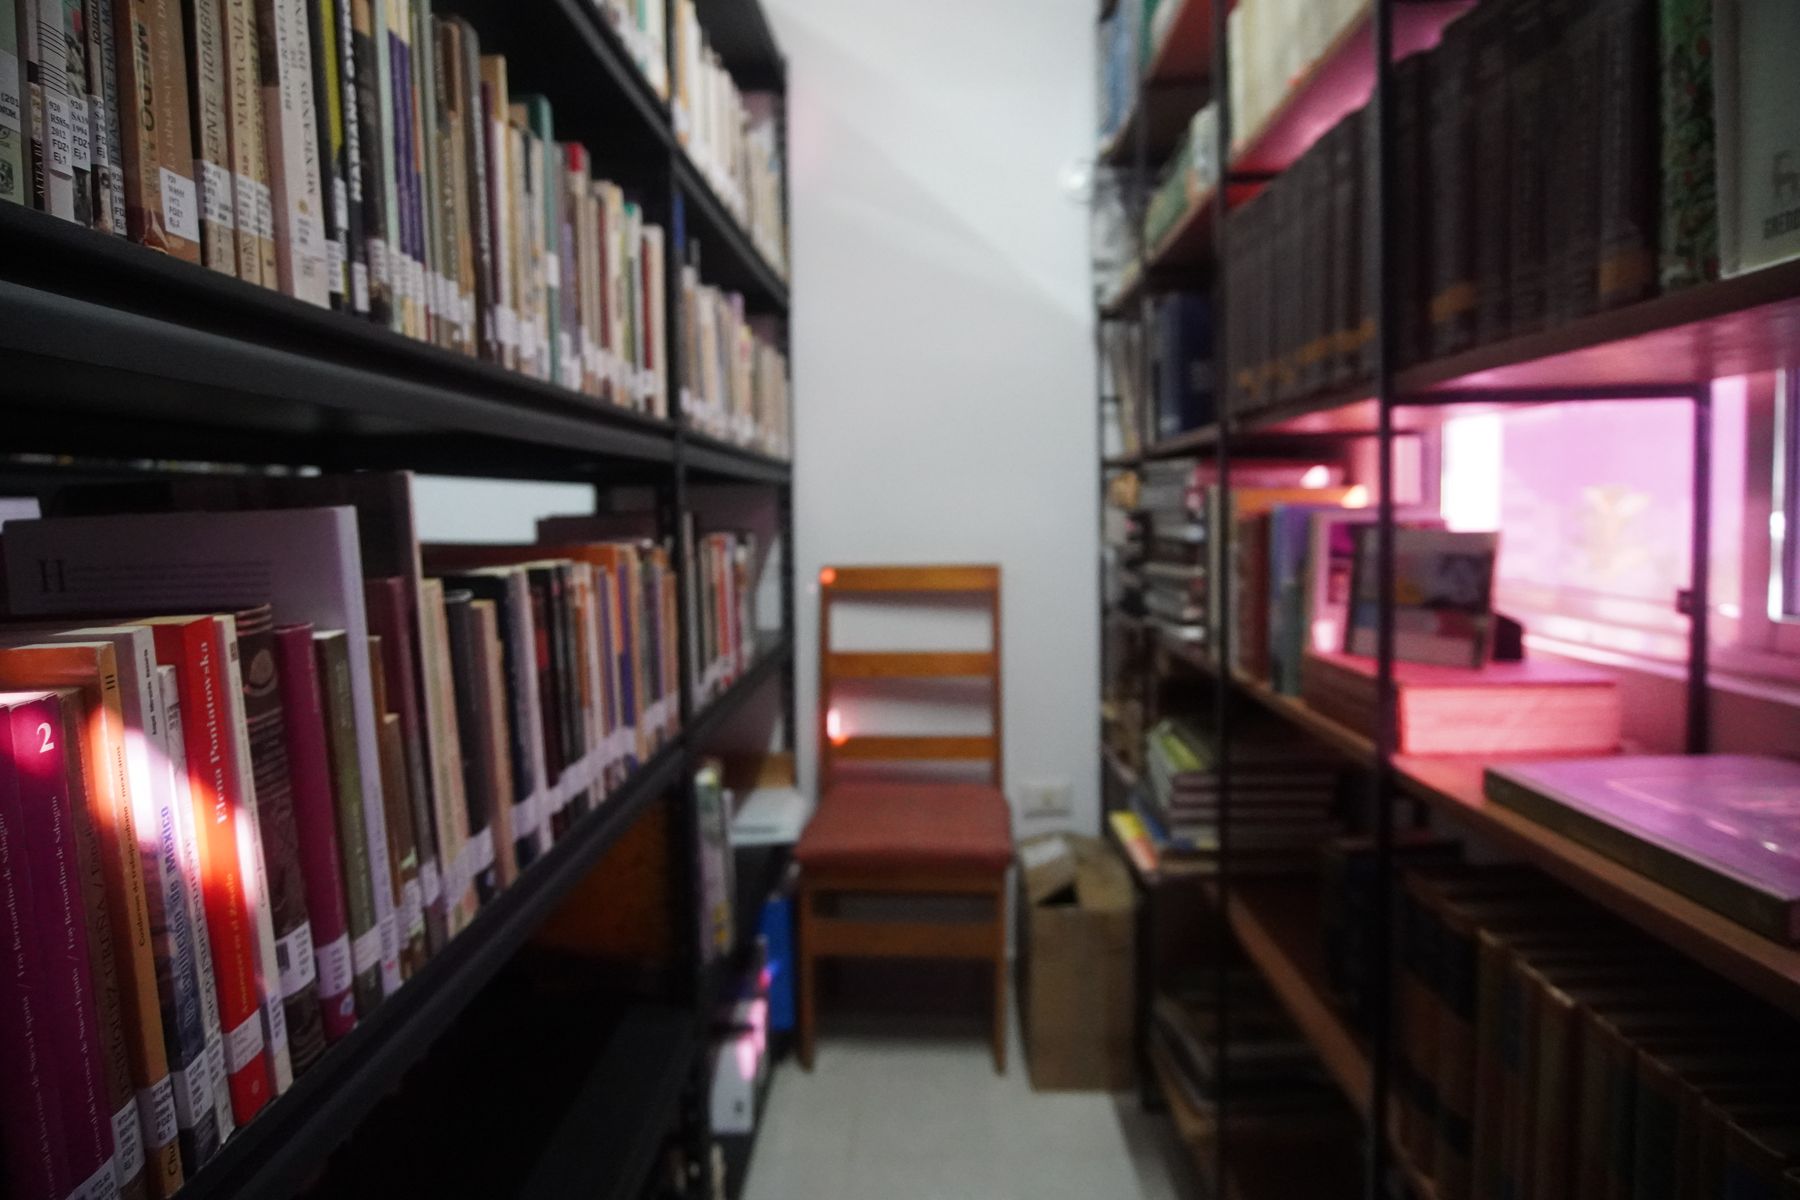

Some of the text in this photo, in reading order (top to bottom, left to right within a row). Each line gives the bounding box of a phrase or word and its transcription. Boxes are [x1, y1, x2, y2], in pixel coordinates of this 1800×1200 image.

[36, 722, 55, 754] 2
[200, 641, 228, 824] Elena Poniatowska
[60, 860, 72, 925] Bernardino
